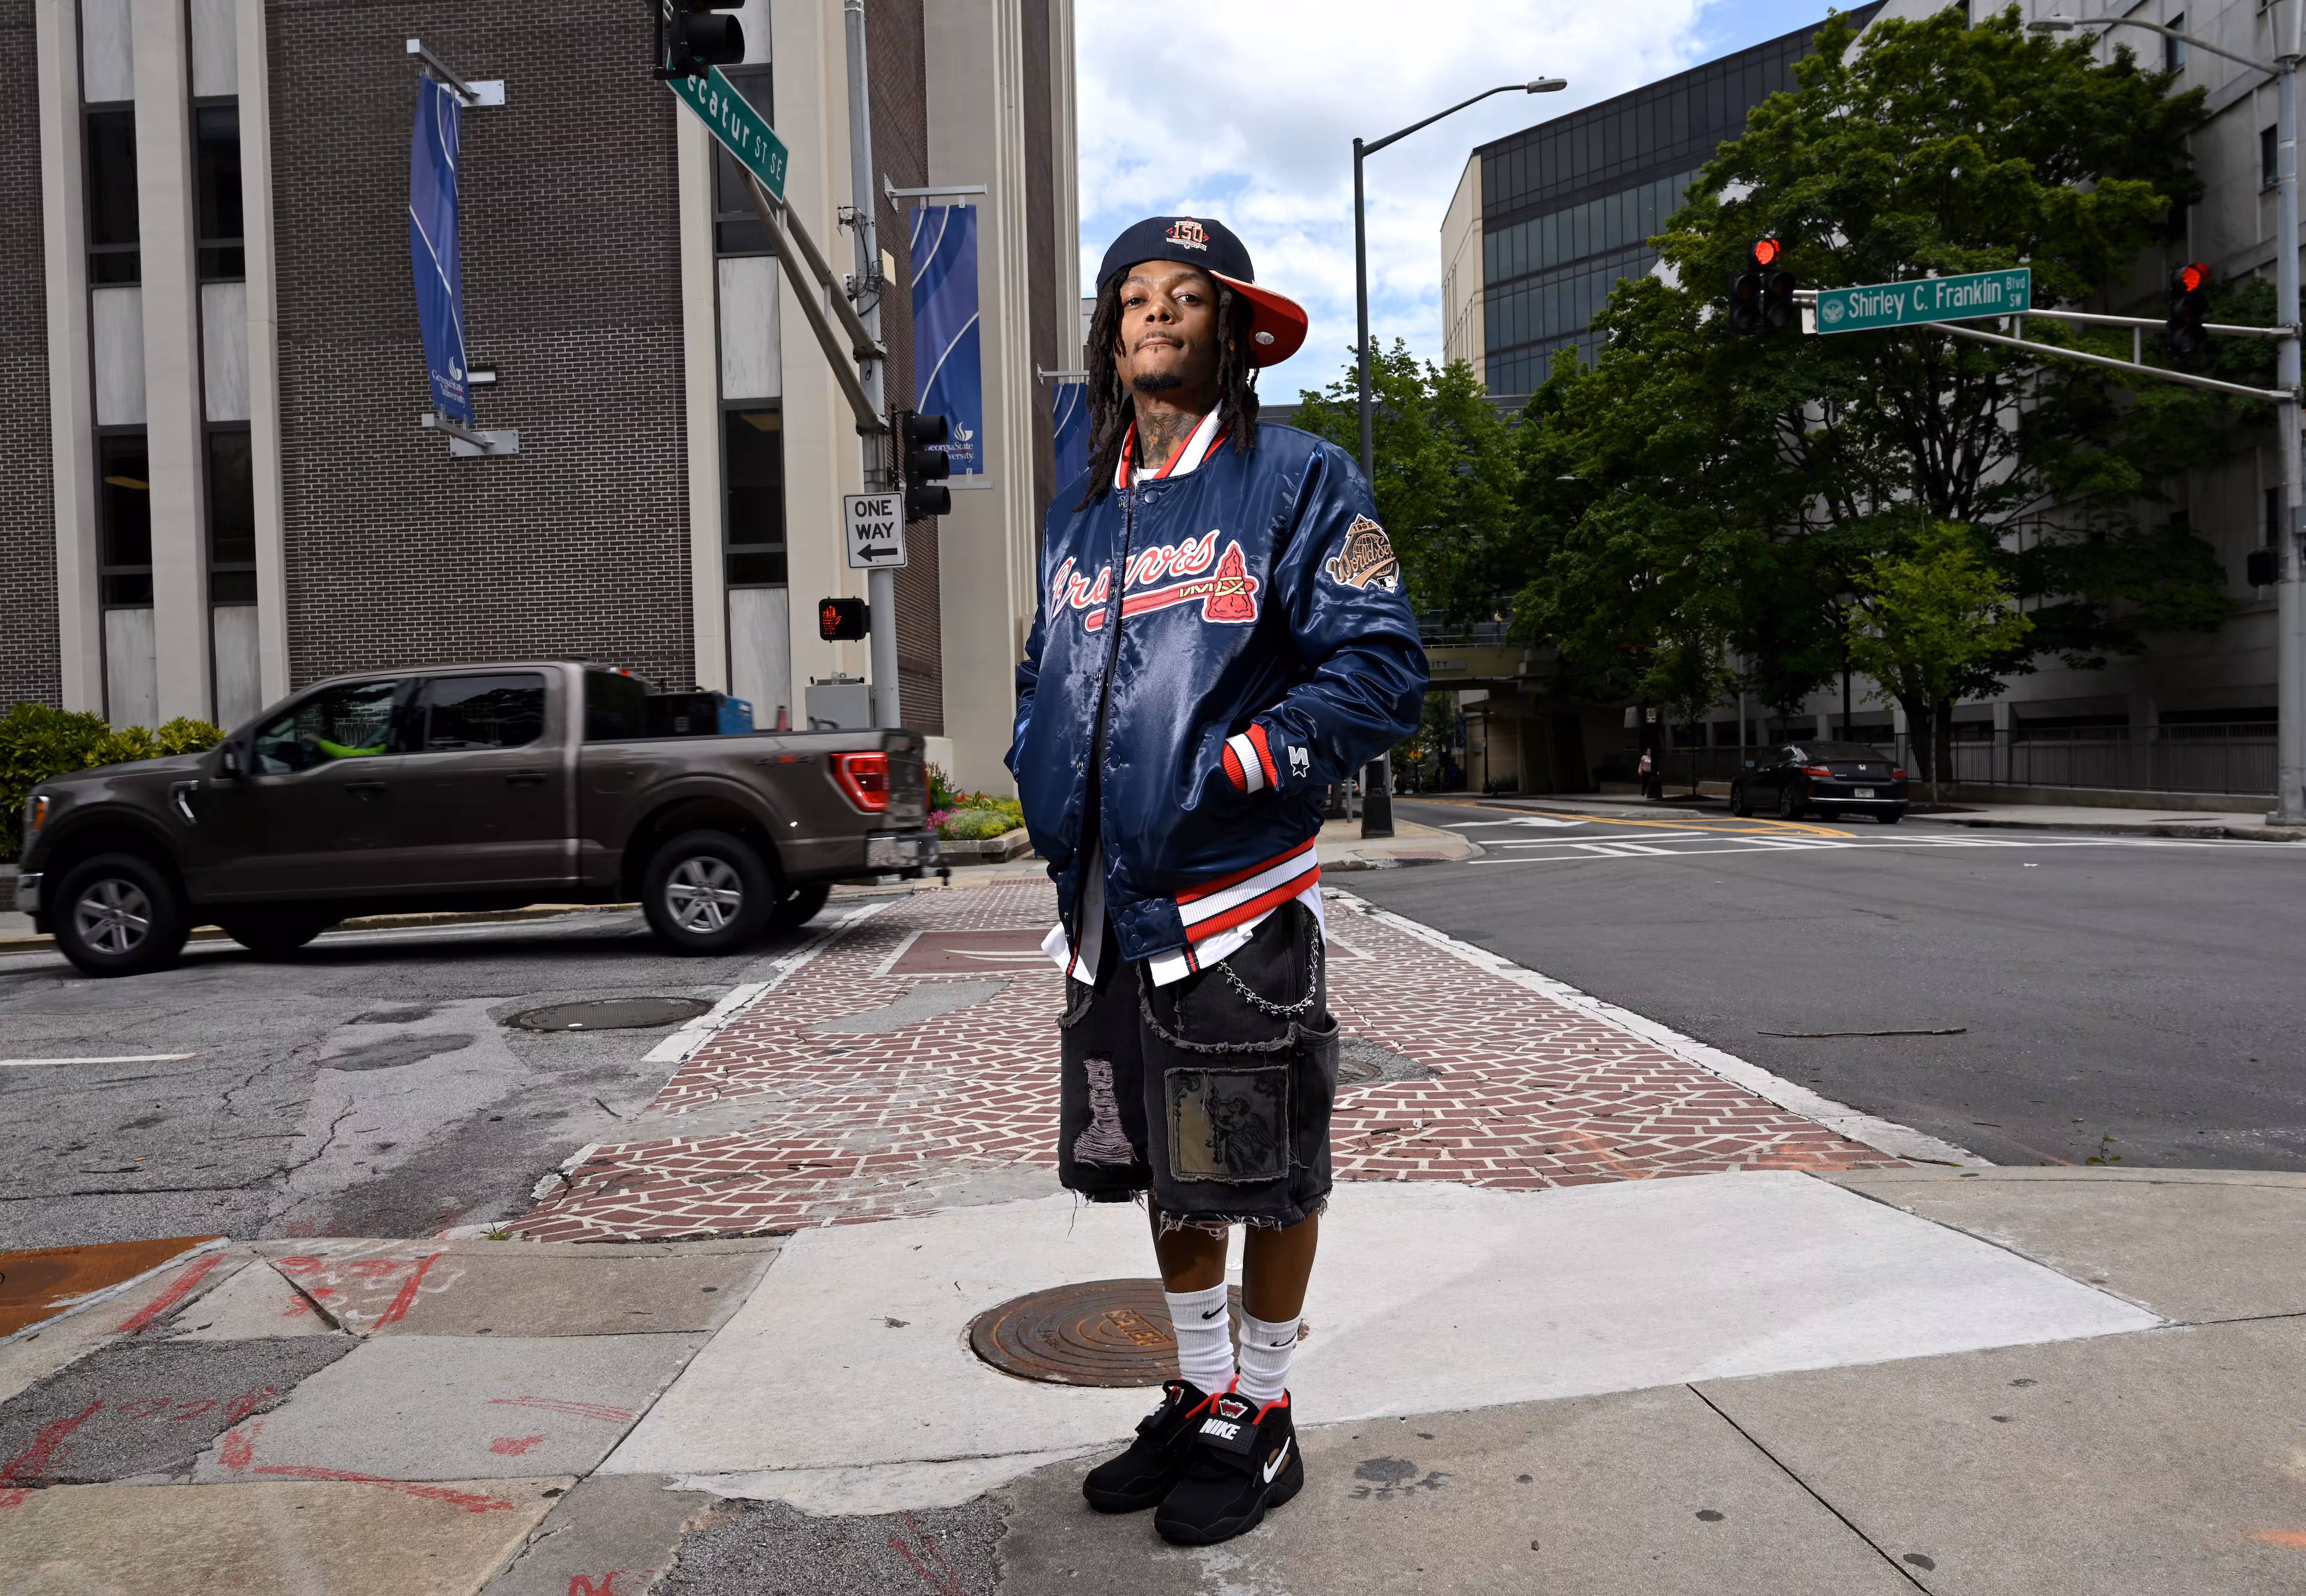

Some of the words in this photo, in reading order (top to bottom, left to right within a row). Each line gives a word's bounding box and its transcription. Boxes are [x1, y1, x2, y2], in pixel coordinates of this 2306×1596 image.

[688, 74, 749, 148] ecatur
[755, 135, 767, 163] ST
[770, 153, 782, 181] SE
[1172, 225, 1203, 243] 150
[2006, 276, 2026, 290] Blvd
[1848, 289, 1905, 321] Shirley
[1913, 285, 1928, 311] C.
[1935, 277, 2001, 309] Franklin
[2009, 292, 2022, 307] SW
[925, 441, 973, 455] eorgiaState
[855, 500, 892, 517] ONE
[855, 522, 894, 540] WAY
[1353, 522, 1373, 531] 1995
[1328, 542, 1378, 582] World
[1105, 1310, 1164, 1346] SEWER
[1199, 1418, 1241, 1440] NIKE
